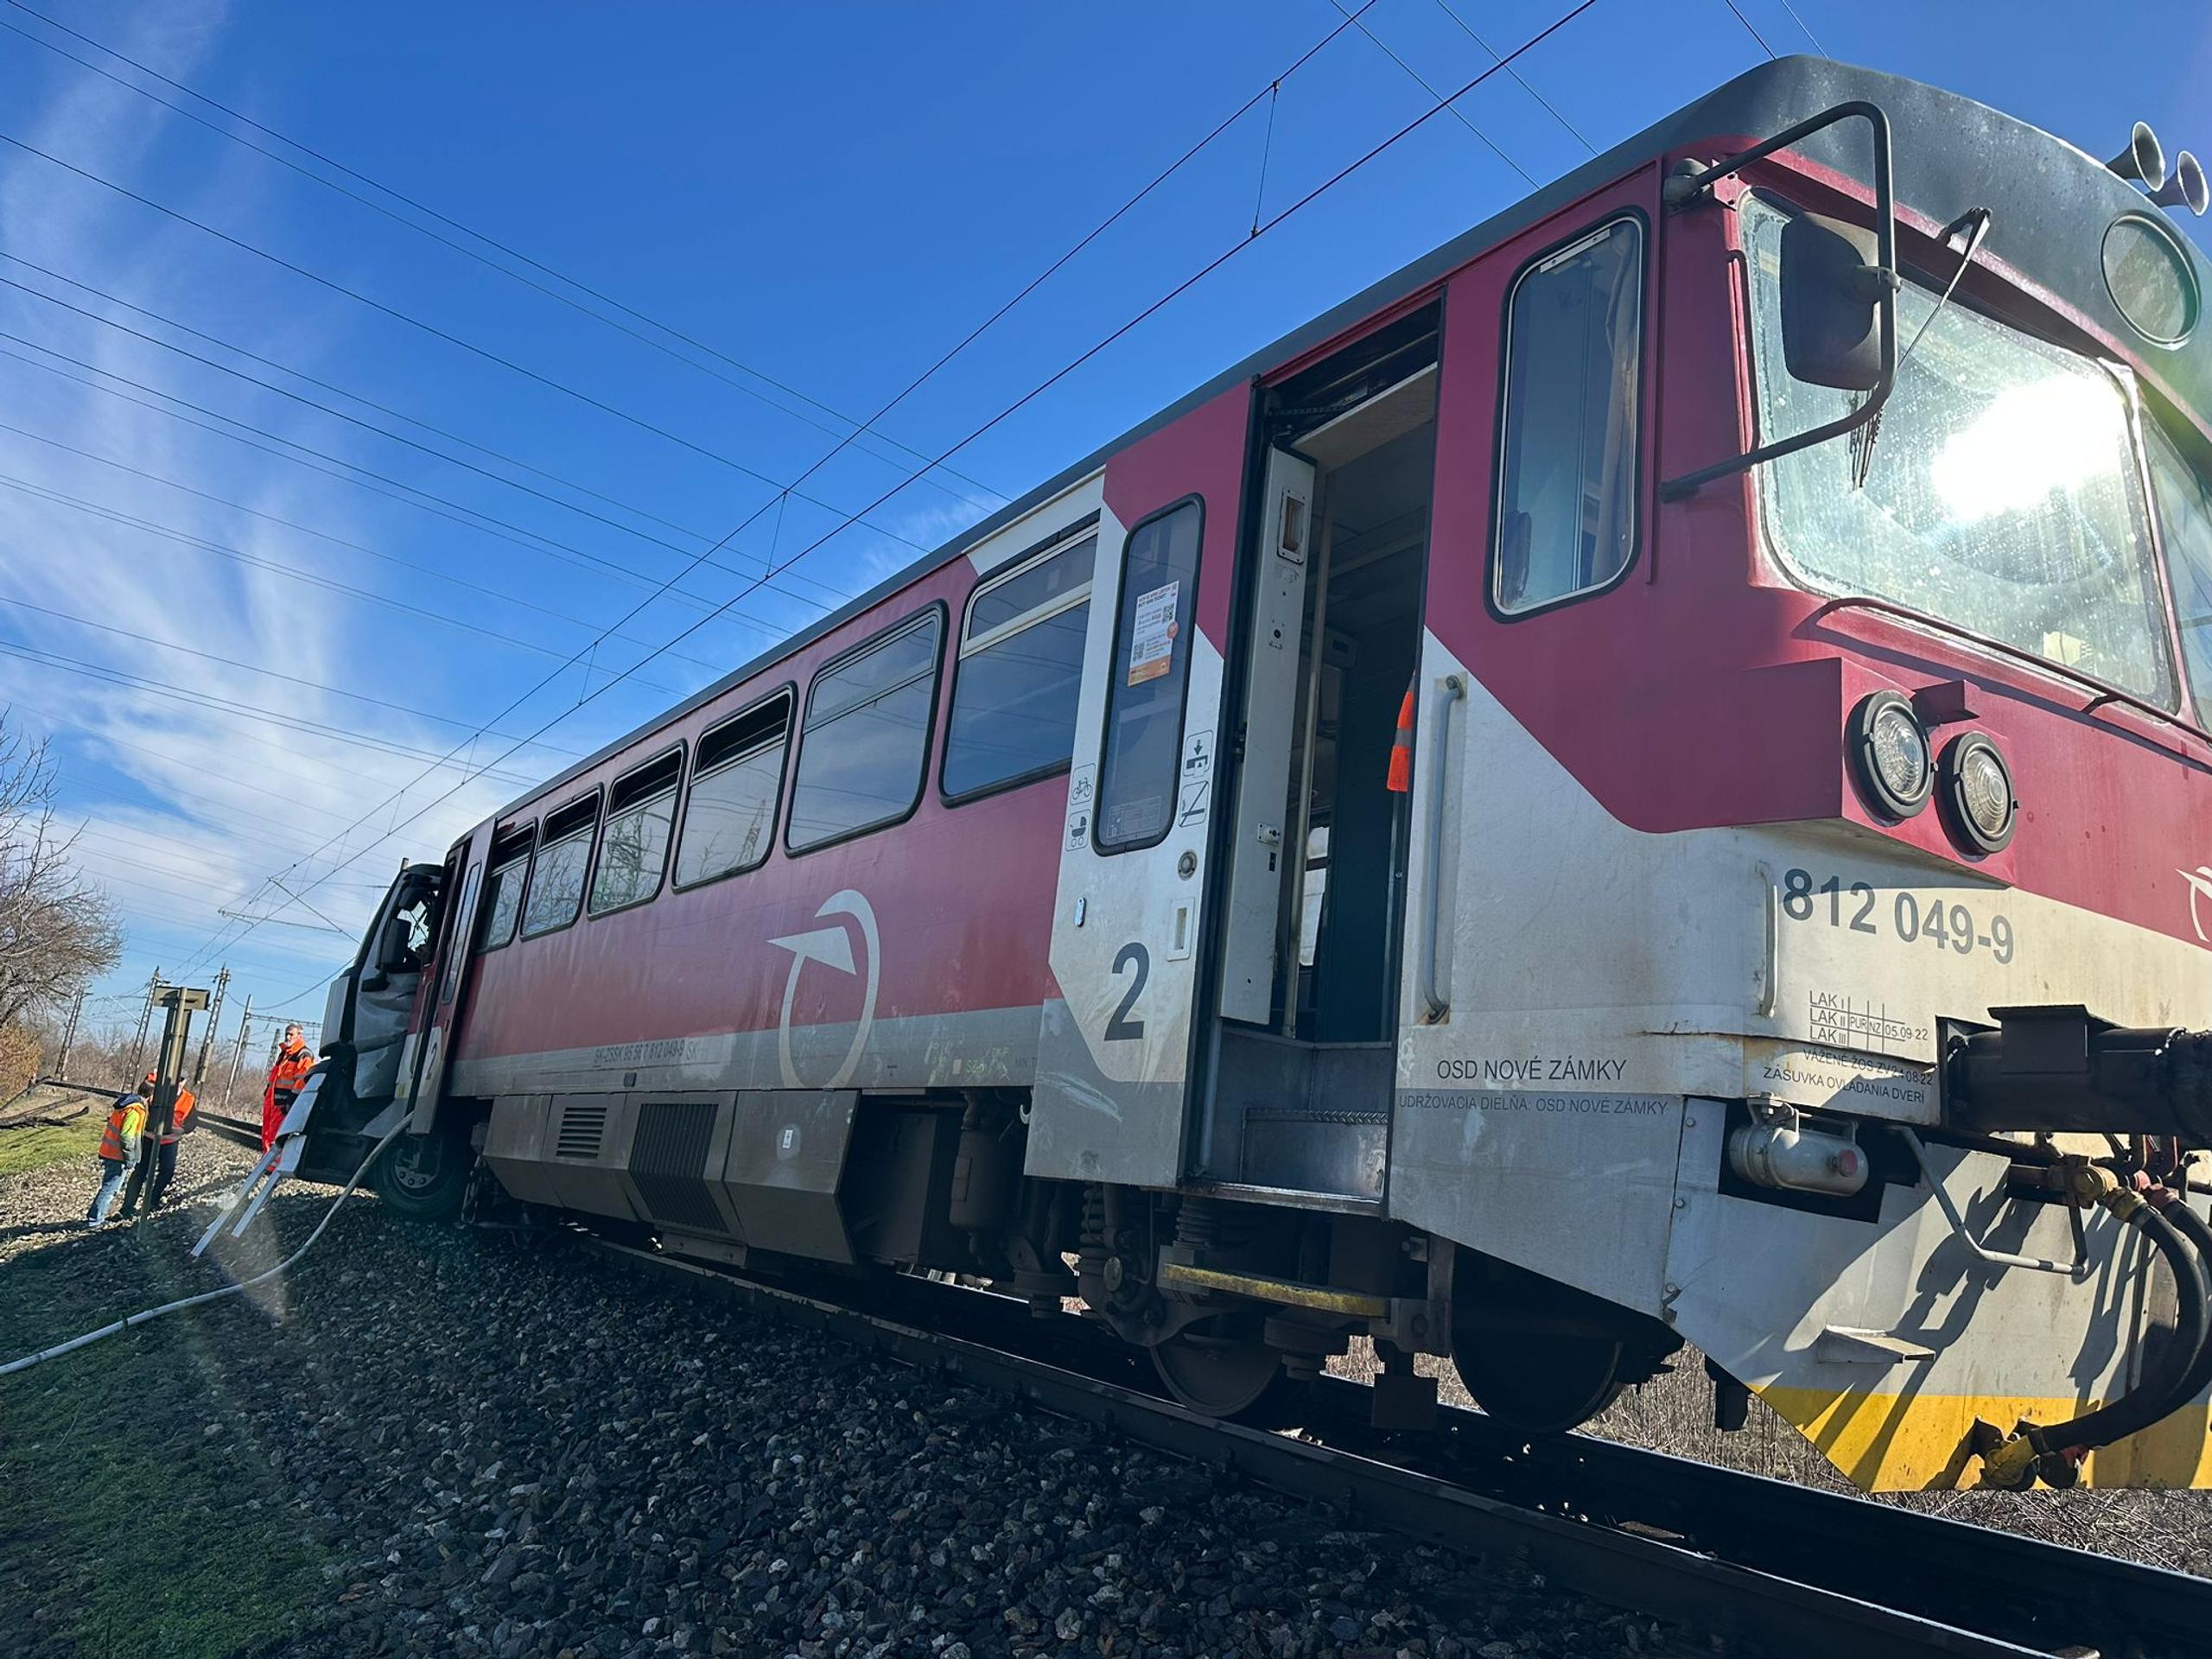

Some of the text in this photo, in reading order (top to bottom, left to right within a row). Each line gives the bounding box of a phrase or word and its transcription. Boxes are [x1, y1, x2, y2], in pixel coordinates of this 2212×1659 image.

[1783, 868, 2014, 964] 812 049-9
[1103, 942, 1151, 1042] 2
[1809, 990, 1838, 1008] LAK
[1809, 1007, 1838, 1027] LAK
[1869, 1020, 1882, 1035] NZ
[1809, 1025, 1837, 1044] LAK
[1436, 1055, 1627, 1080] OSD NOVÉ ZÁMKY
[1764, 1064, 1825, 1086] ZÁSUVKA
[1399, 1092, 1478, 1110] UDRŽOVACIA
[1535, 1098, 1566, 1113] OSD
[1569, 1096, 1610, 1114] NOVÉ
[1613, 1096, 1668, 1116] ZÁMKY
